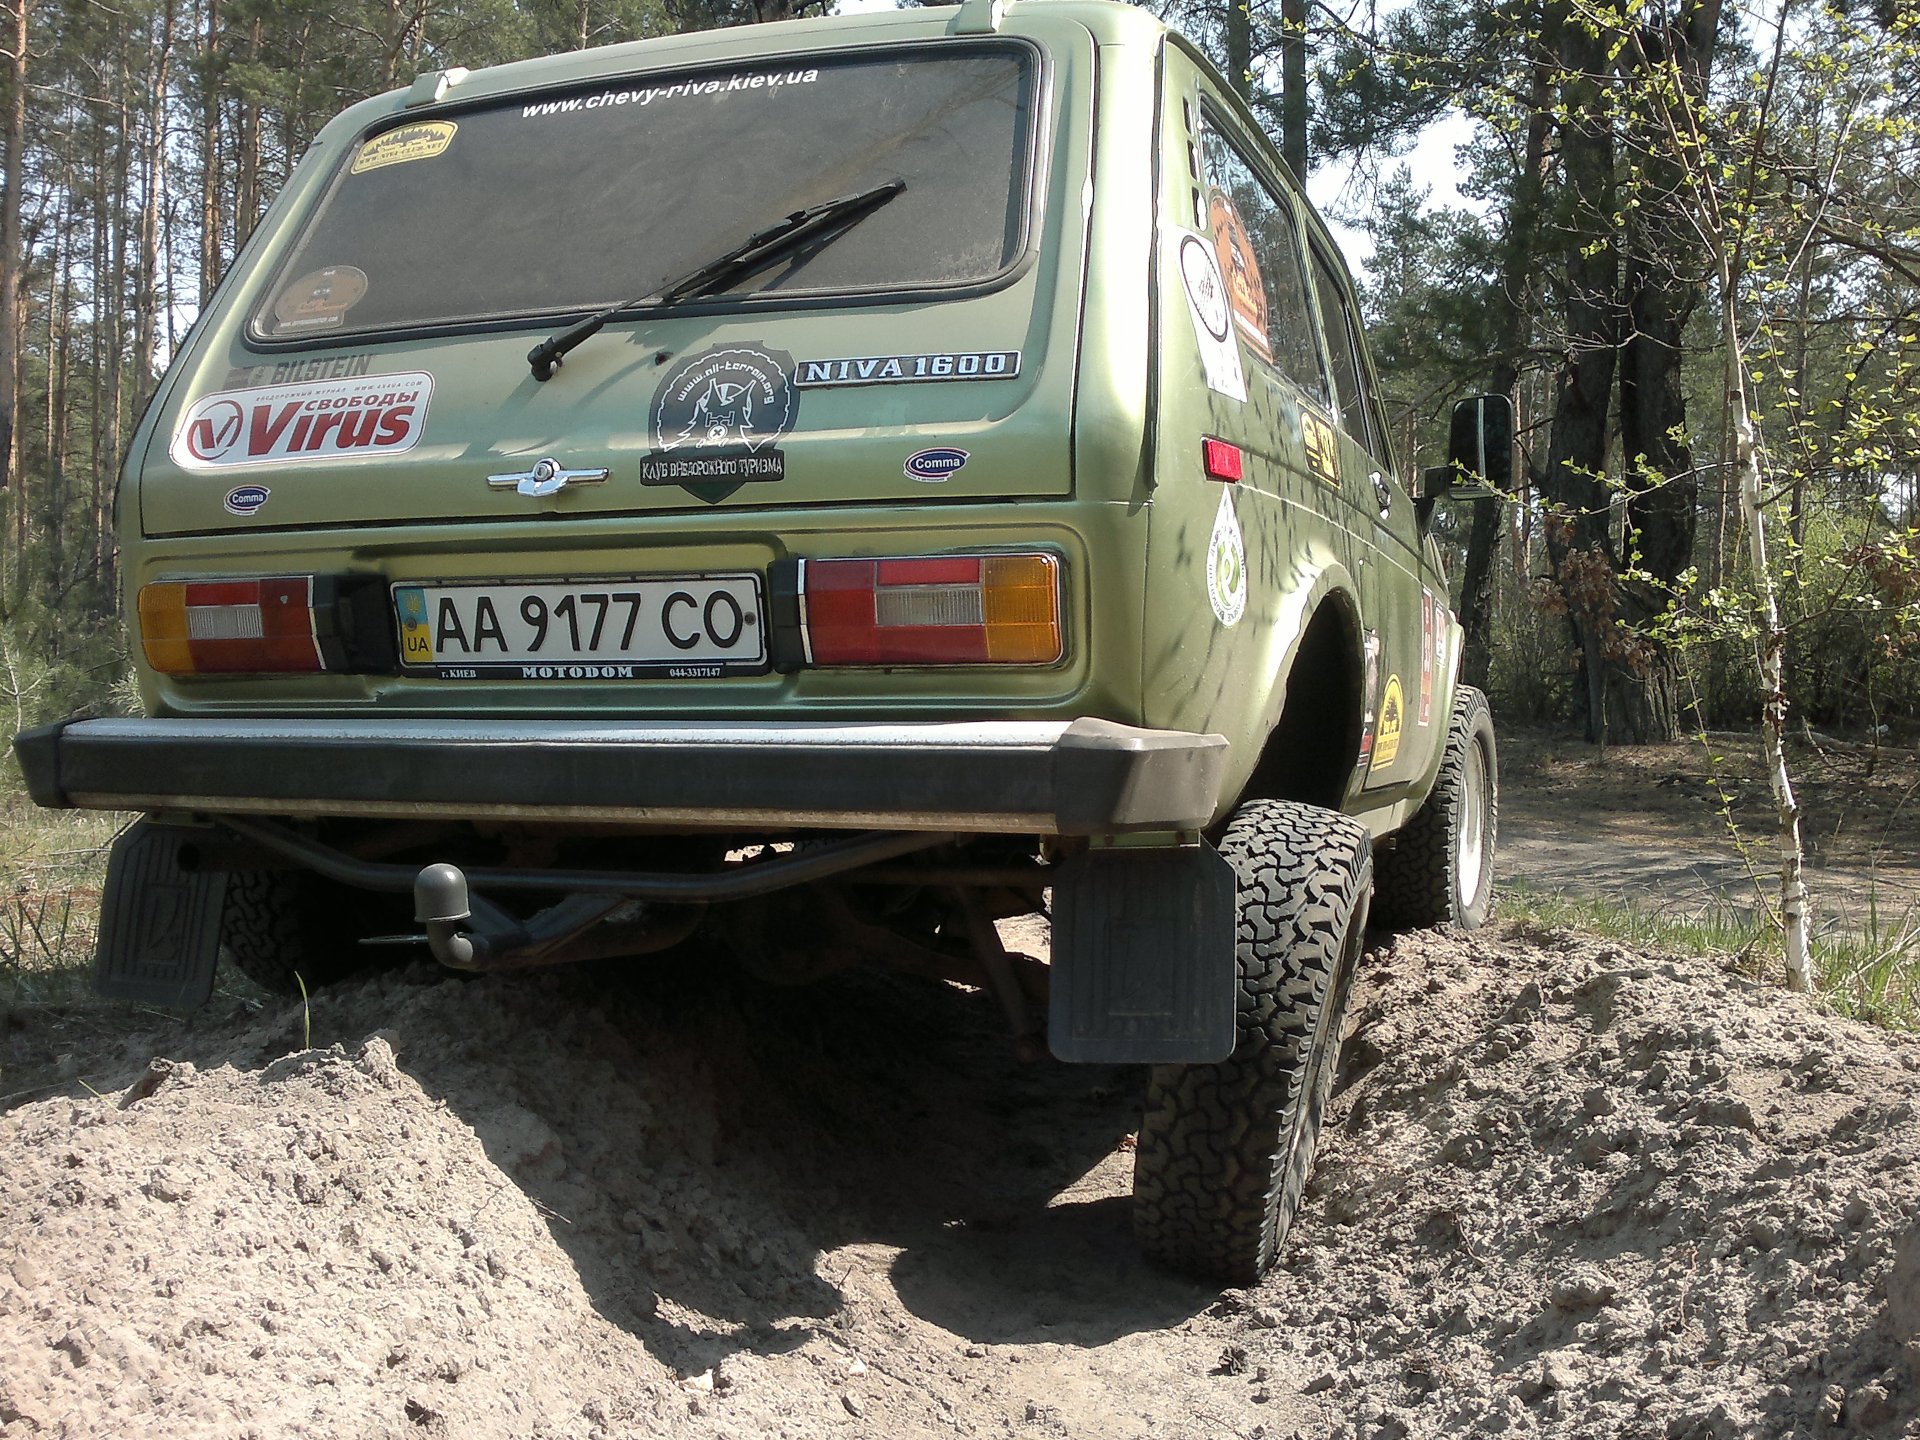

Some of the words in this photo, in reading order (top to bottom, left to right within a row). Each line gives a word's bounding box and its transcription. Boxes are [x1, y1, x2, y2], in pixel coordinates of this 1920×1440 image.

[522, 69, 819, 118] www.chevy-riva.kiev.ua
[270, 354, 373, 385] BILSTEIN
[805, 358, 903, 382] NIVA
[914, 353, 1006, 377] 1600
[677, 361, 775, 405] www.all-terrain.org
[303, 391, 420, 411] СВОБОДЫ
[247, 400, 416, 456] Virus
[642, 462, 667, 480] КЛУБ
[739, 456, 783, 477] ТУРИЗМА
[915, 458, 960, 469] Comma
[232, 493, 264, 503] Comma
[435, 596, 509, 653] AA
[520, 592, 643, 652] 9177
[407, 636, 429, 654] UA
[522, 666, 634, 679] MOTODOM
[669, 667, 721, 678] 044-3317147
